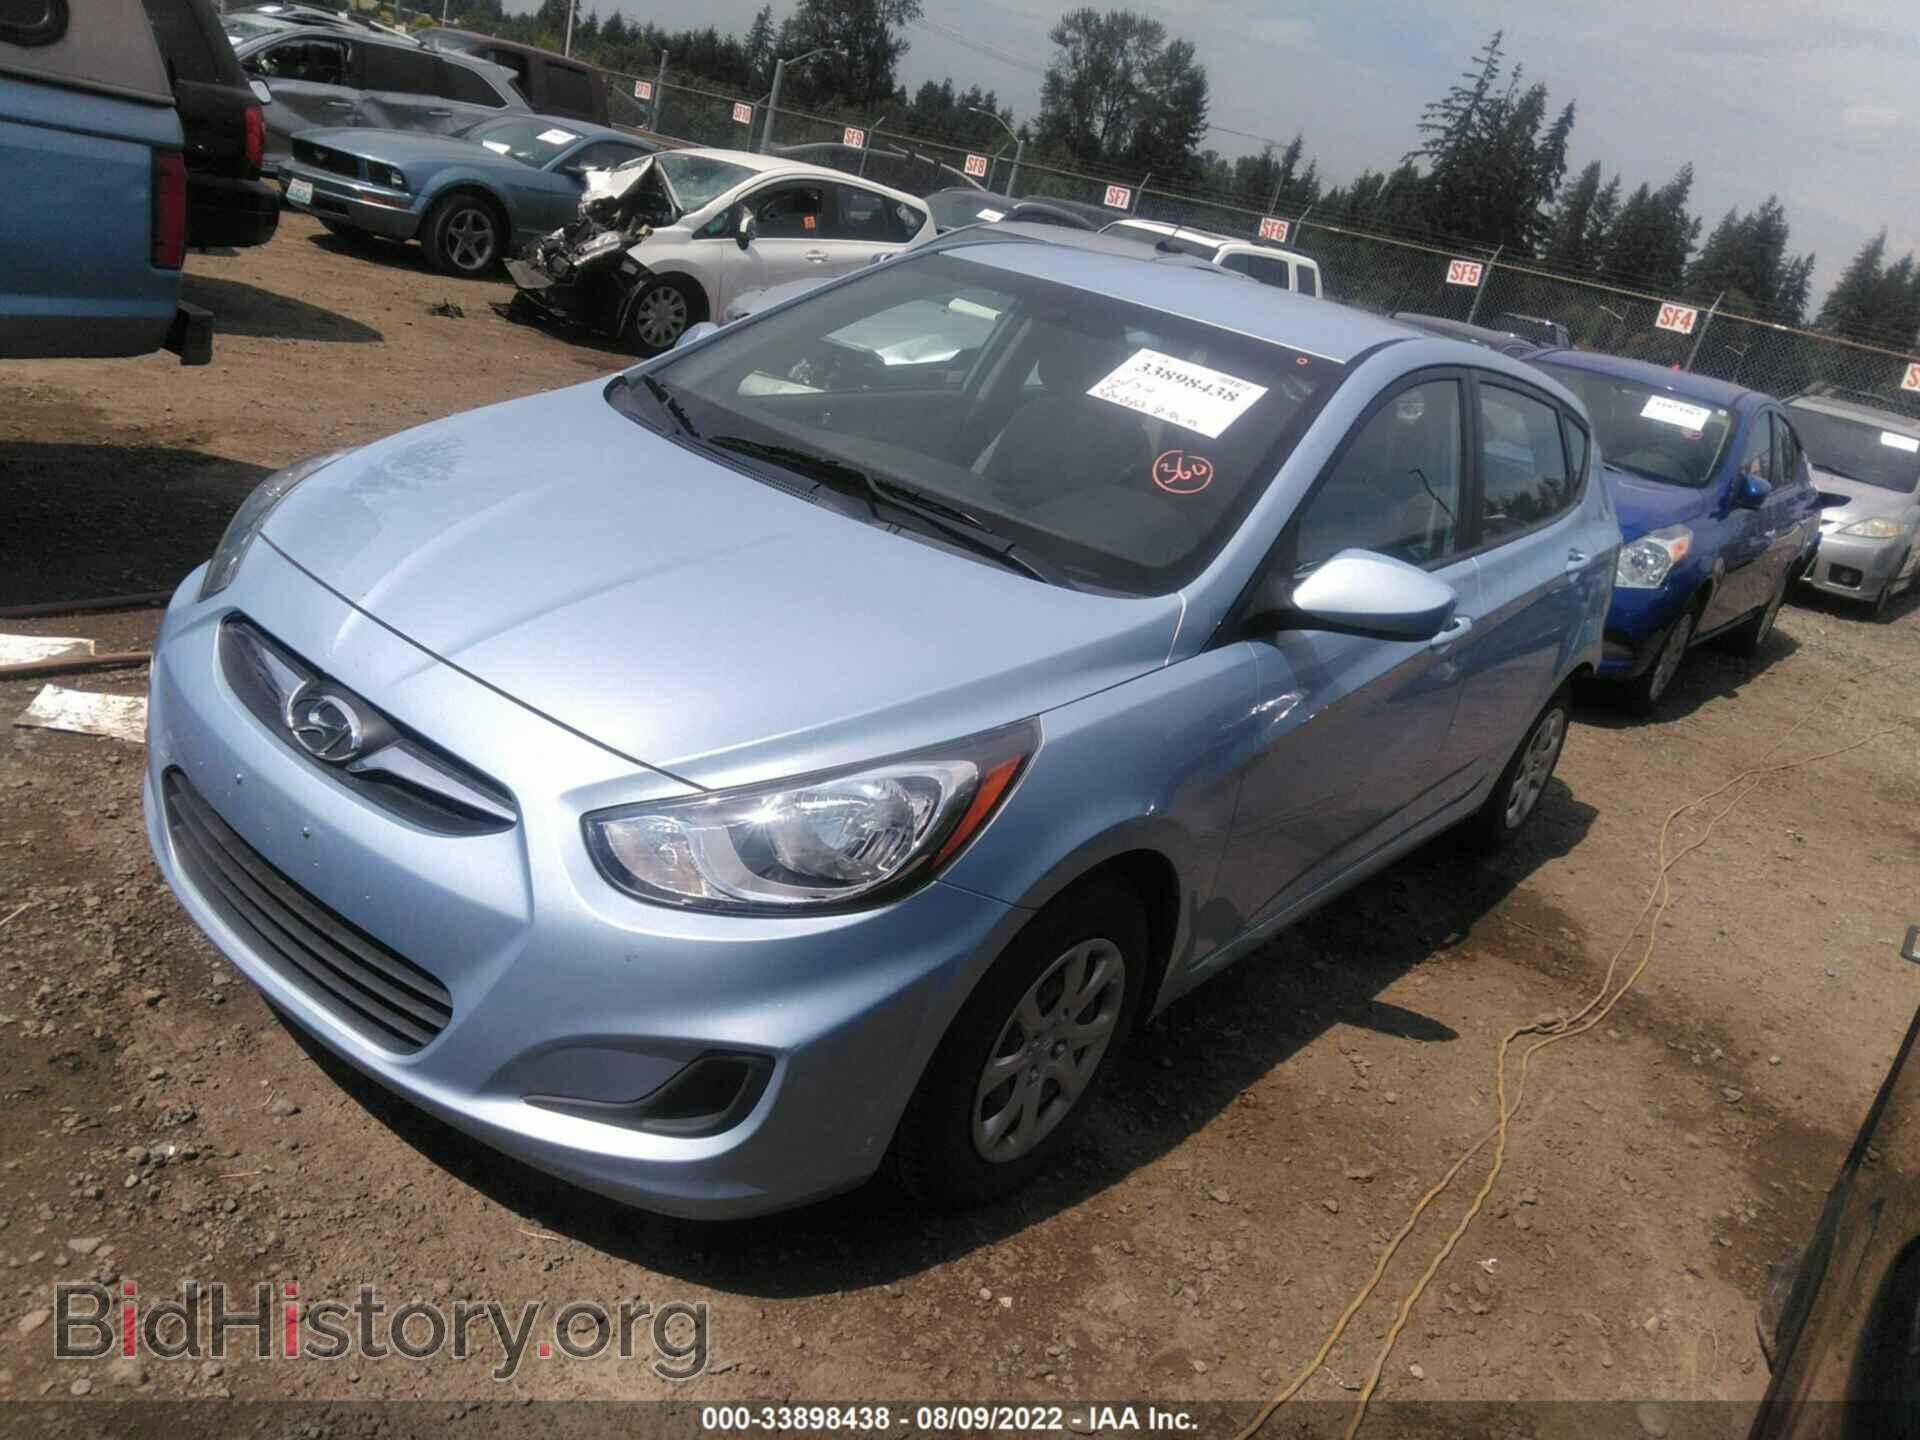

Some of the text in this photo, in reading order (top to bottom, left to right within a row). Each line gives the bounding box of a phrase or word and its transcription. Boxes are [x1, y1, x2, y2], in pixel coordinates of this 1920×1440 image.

[845, 129, 863, 146] SF9
[967, 157, 986, 175] SF8
[1107, 187, 1129, 207] SF7
[1261, 219, 1287, 241] SF6
[1450, 262, 1480, 283] SF5
[1660, 306, 1693, 330] SF4
[1135, 362, 1240, 402] 33898438
